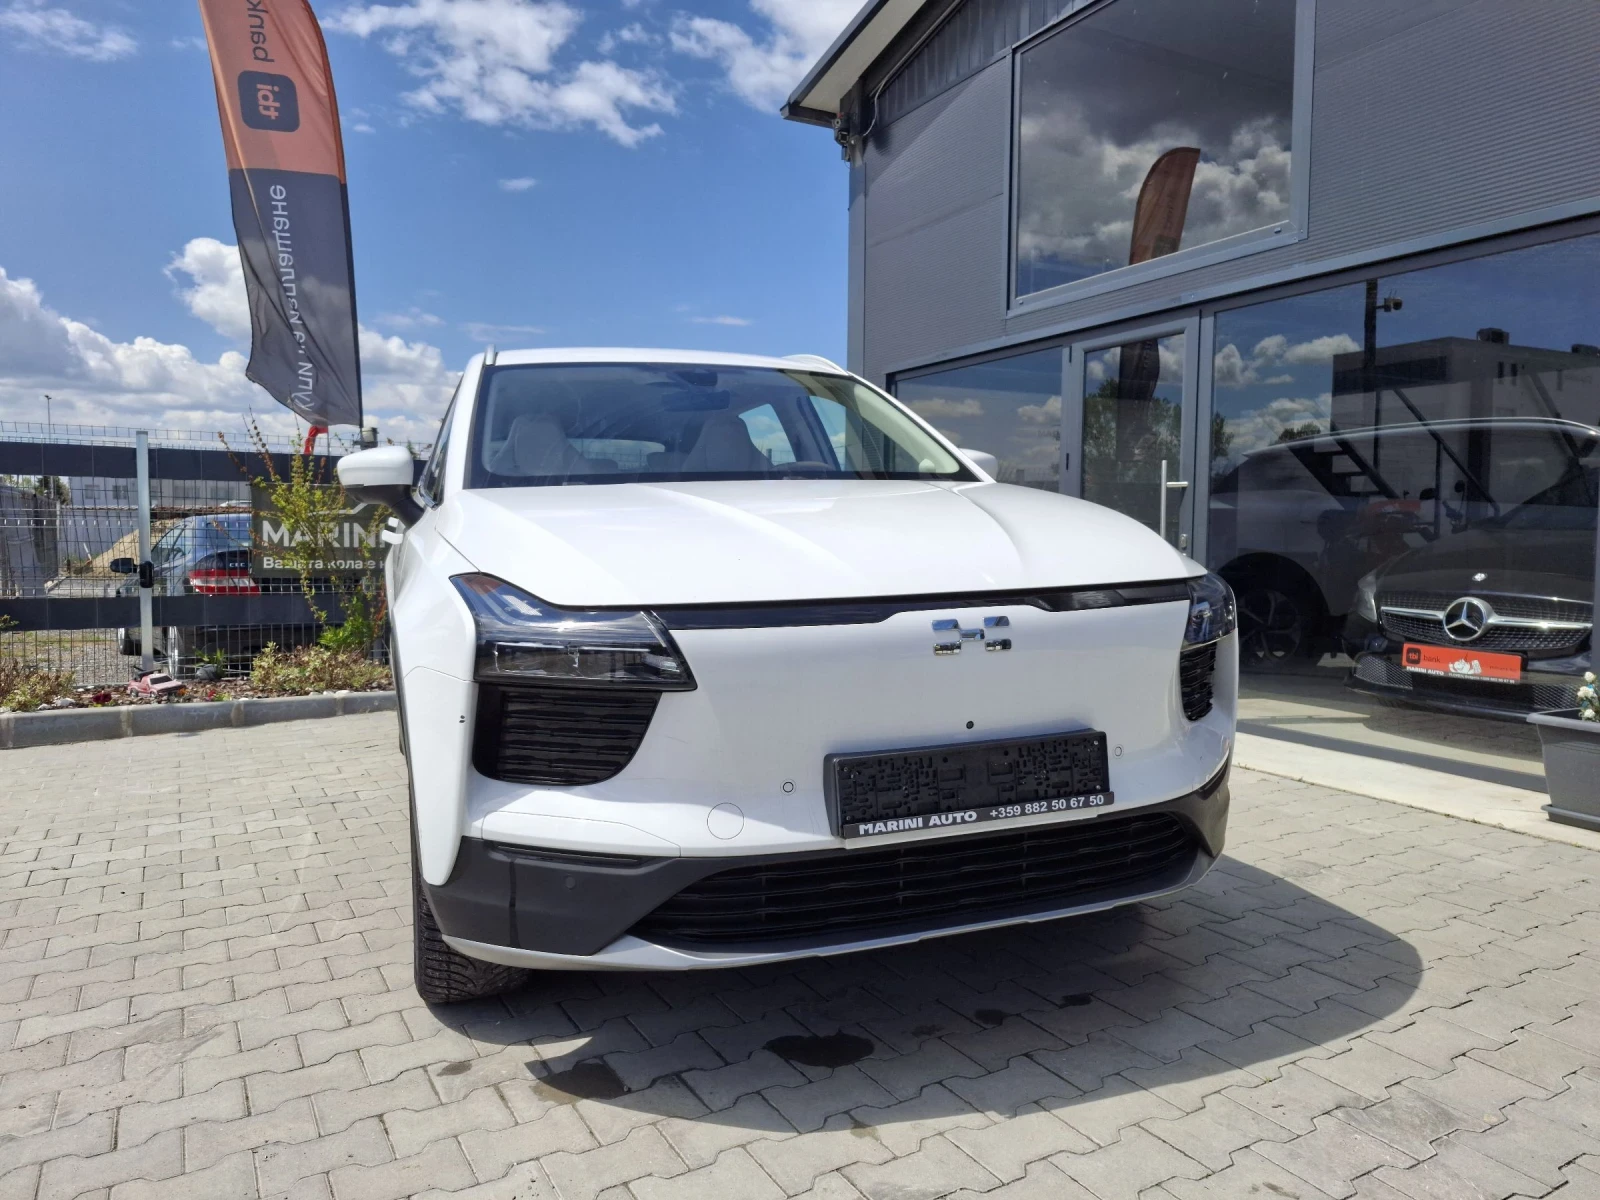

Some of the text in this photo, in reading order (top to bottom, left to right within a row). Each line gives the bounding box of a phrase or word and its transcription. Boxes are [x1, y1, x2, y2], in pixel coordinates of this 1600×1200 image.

[327, 559, 363, 569] кола
[1423, 654, 1441, 663] bank
[859, 794, 1105, 836] MARINI AUTO +359 882 50 67 50
